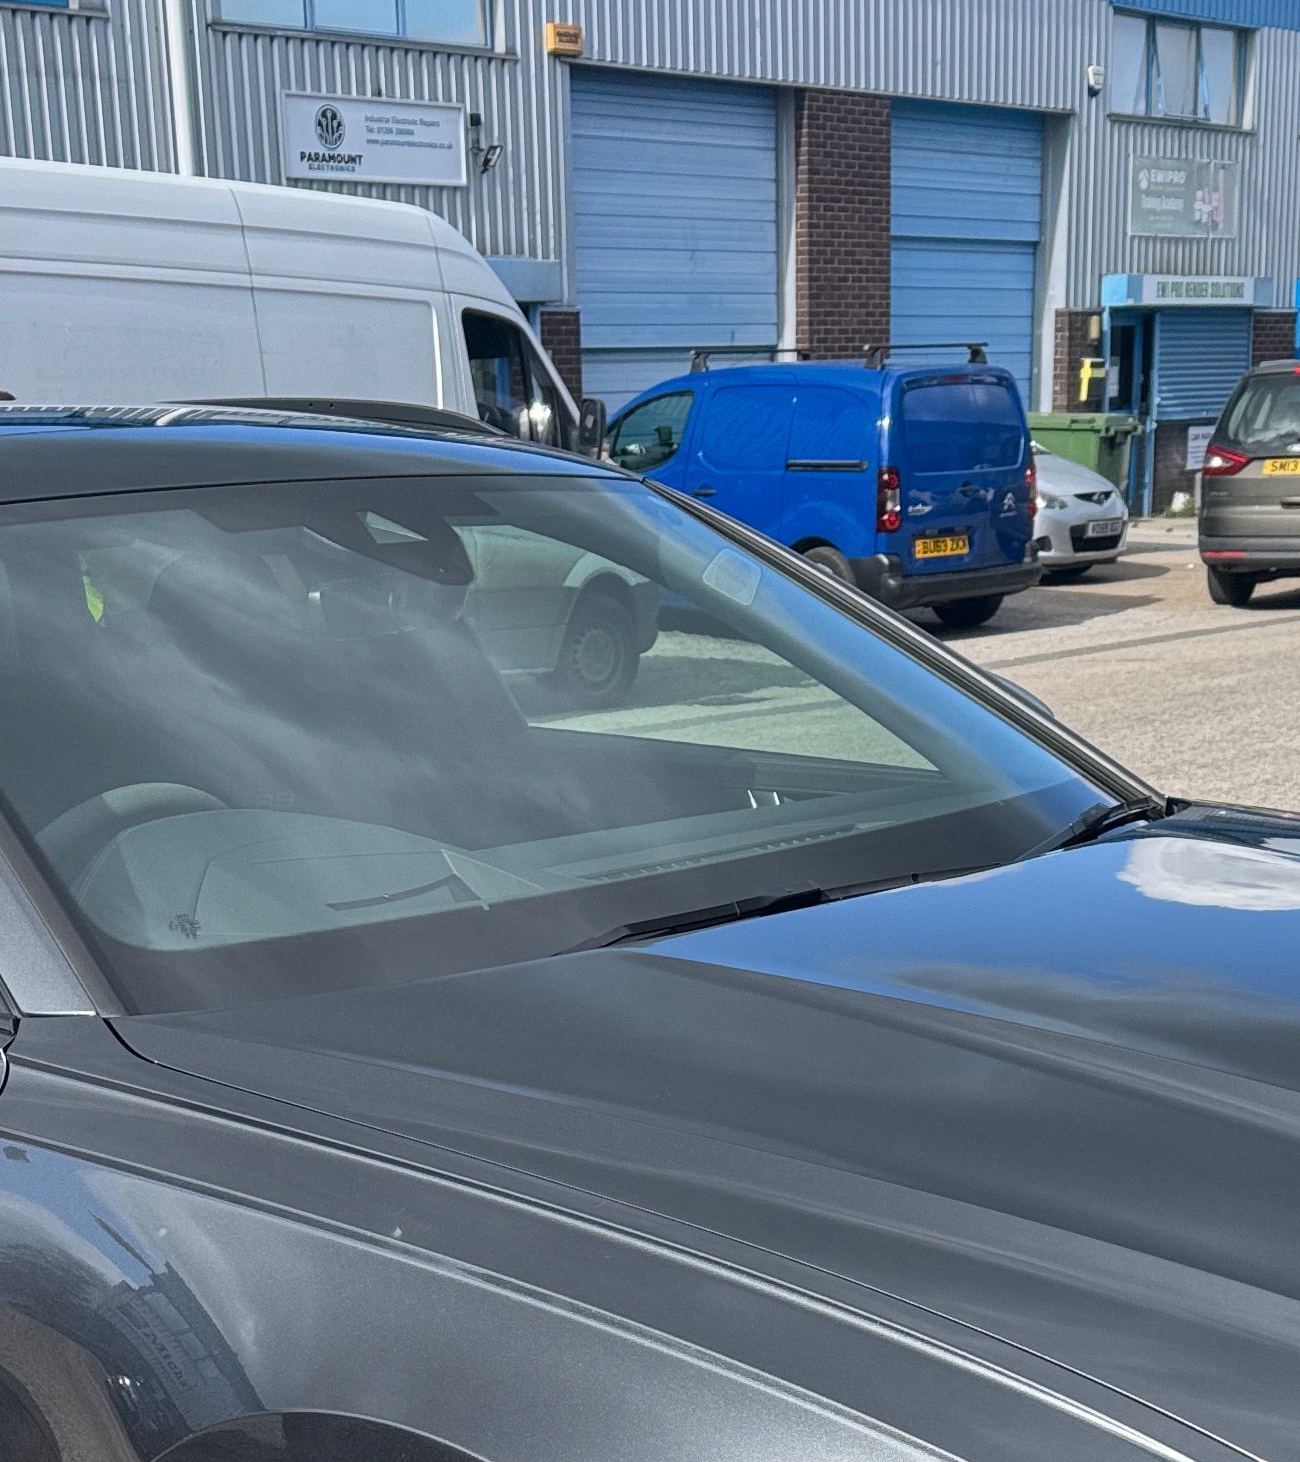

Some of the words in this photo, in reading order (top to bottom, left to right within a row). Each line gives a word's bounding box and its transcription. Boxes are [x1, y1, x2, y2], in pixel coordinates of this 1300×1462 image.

[300, 151, 363, 166] PARAMOUNT
[308, 163, 356, 173] ELECTRONICS
[1270, 460, 1300, 472] SM13
